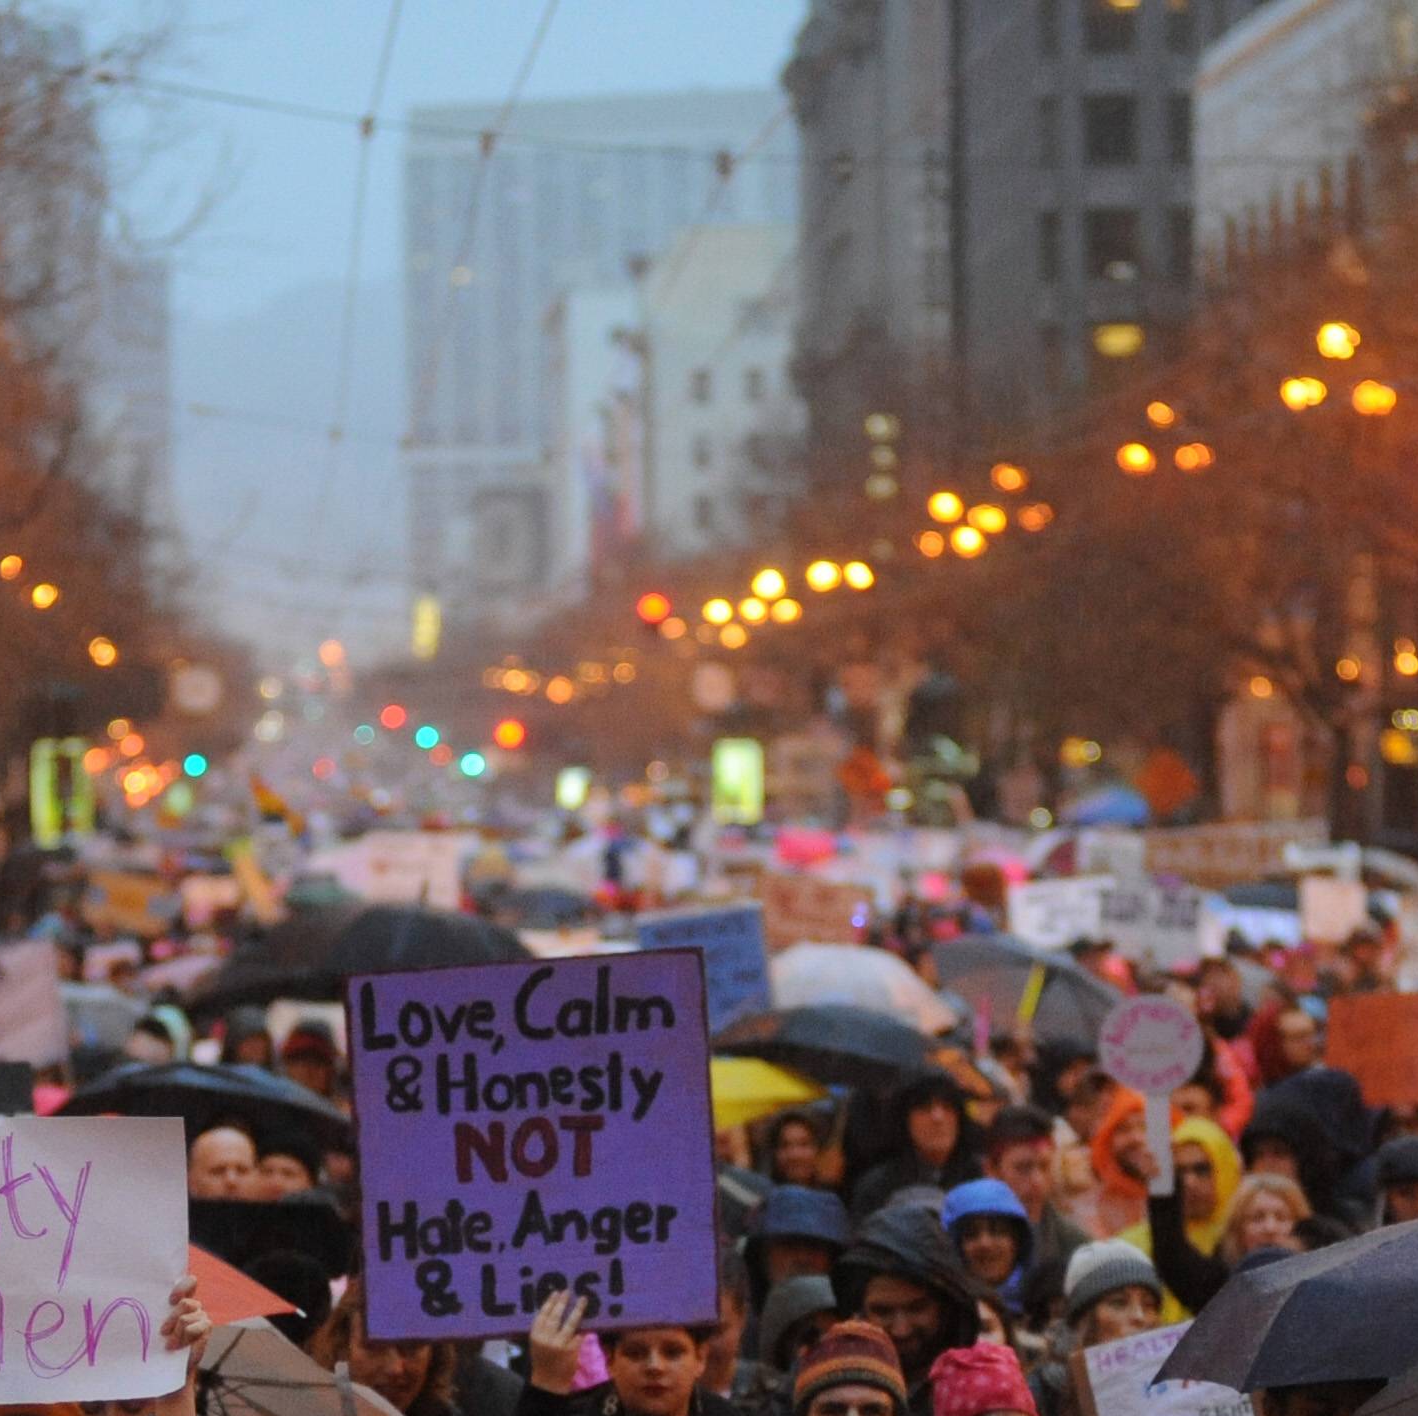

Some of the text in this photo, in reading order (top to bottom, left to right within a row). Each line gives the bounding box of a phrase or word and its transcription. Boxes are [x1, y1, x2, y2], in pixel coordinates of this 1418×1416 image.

[360, 965, 676, 1055] Love, Calm
[385, 1055, 424, 1114] &
[454, 1115, 604, 1183] NOT
[512, 1190, 678, 1255] Anger
[415, 1257, 624, 1319] & Lies!
[1095, 1328, 1187, 1375] HEALT
